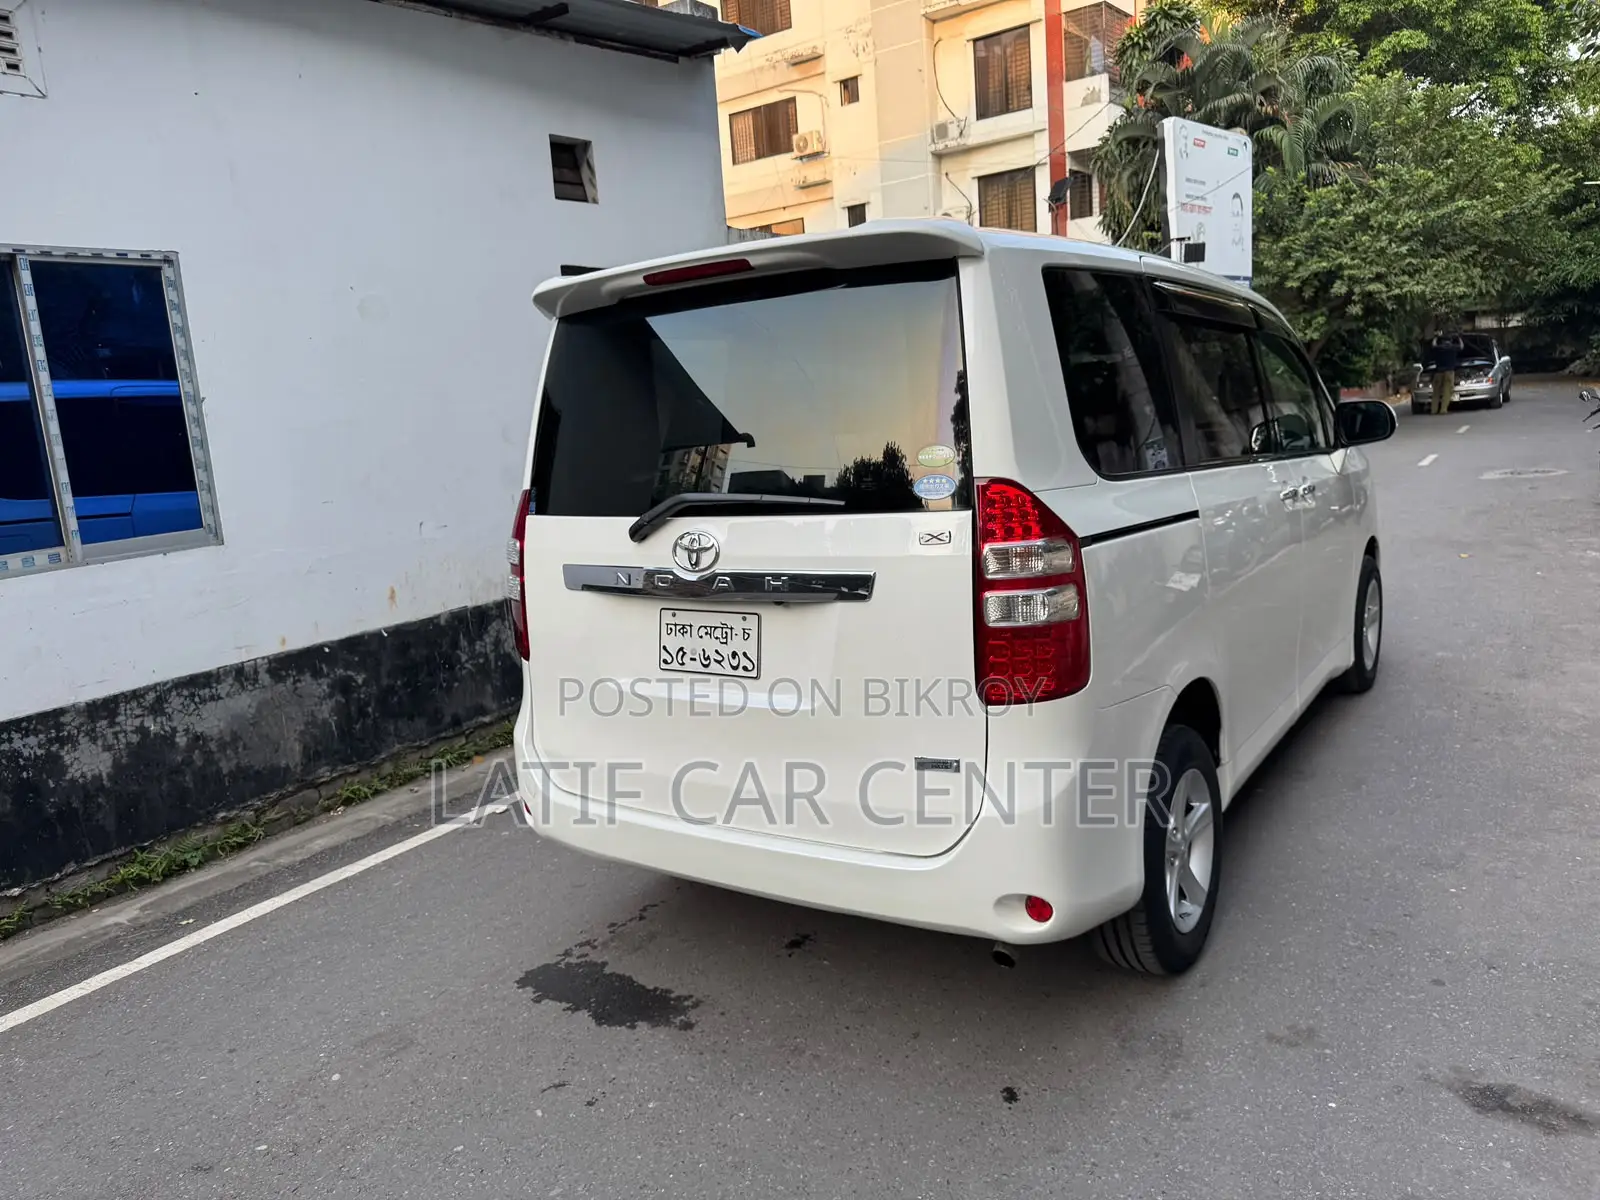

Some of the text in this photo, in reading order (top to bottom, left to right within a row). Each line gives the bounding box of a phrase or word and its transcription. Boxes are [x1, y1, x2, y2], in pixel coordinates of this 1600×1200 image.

[665, 622, 693, 638] ঢাকা
[742, 627, 752, 641] চ
[662, 645, 755, 672] ১৫-৬২৩১
